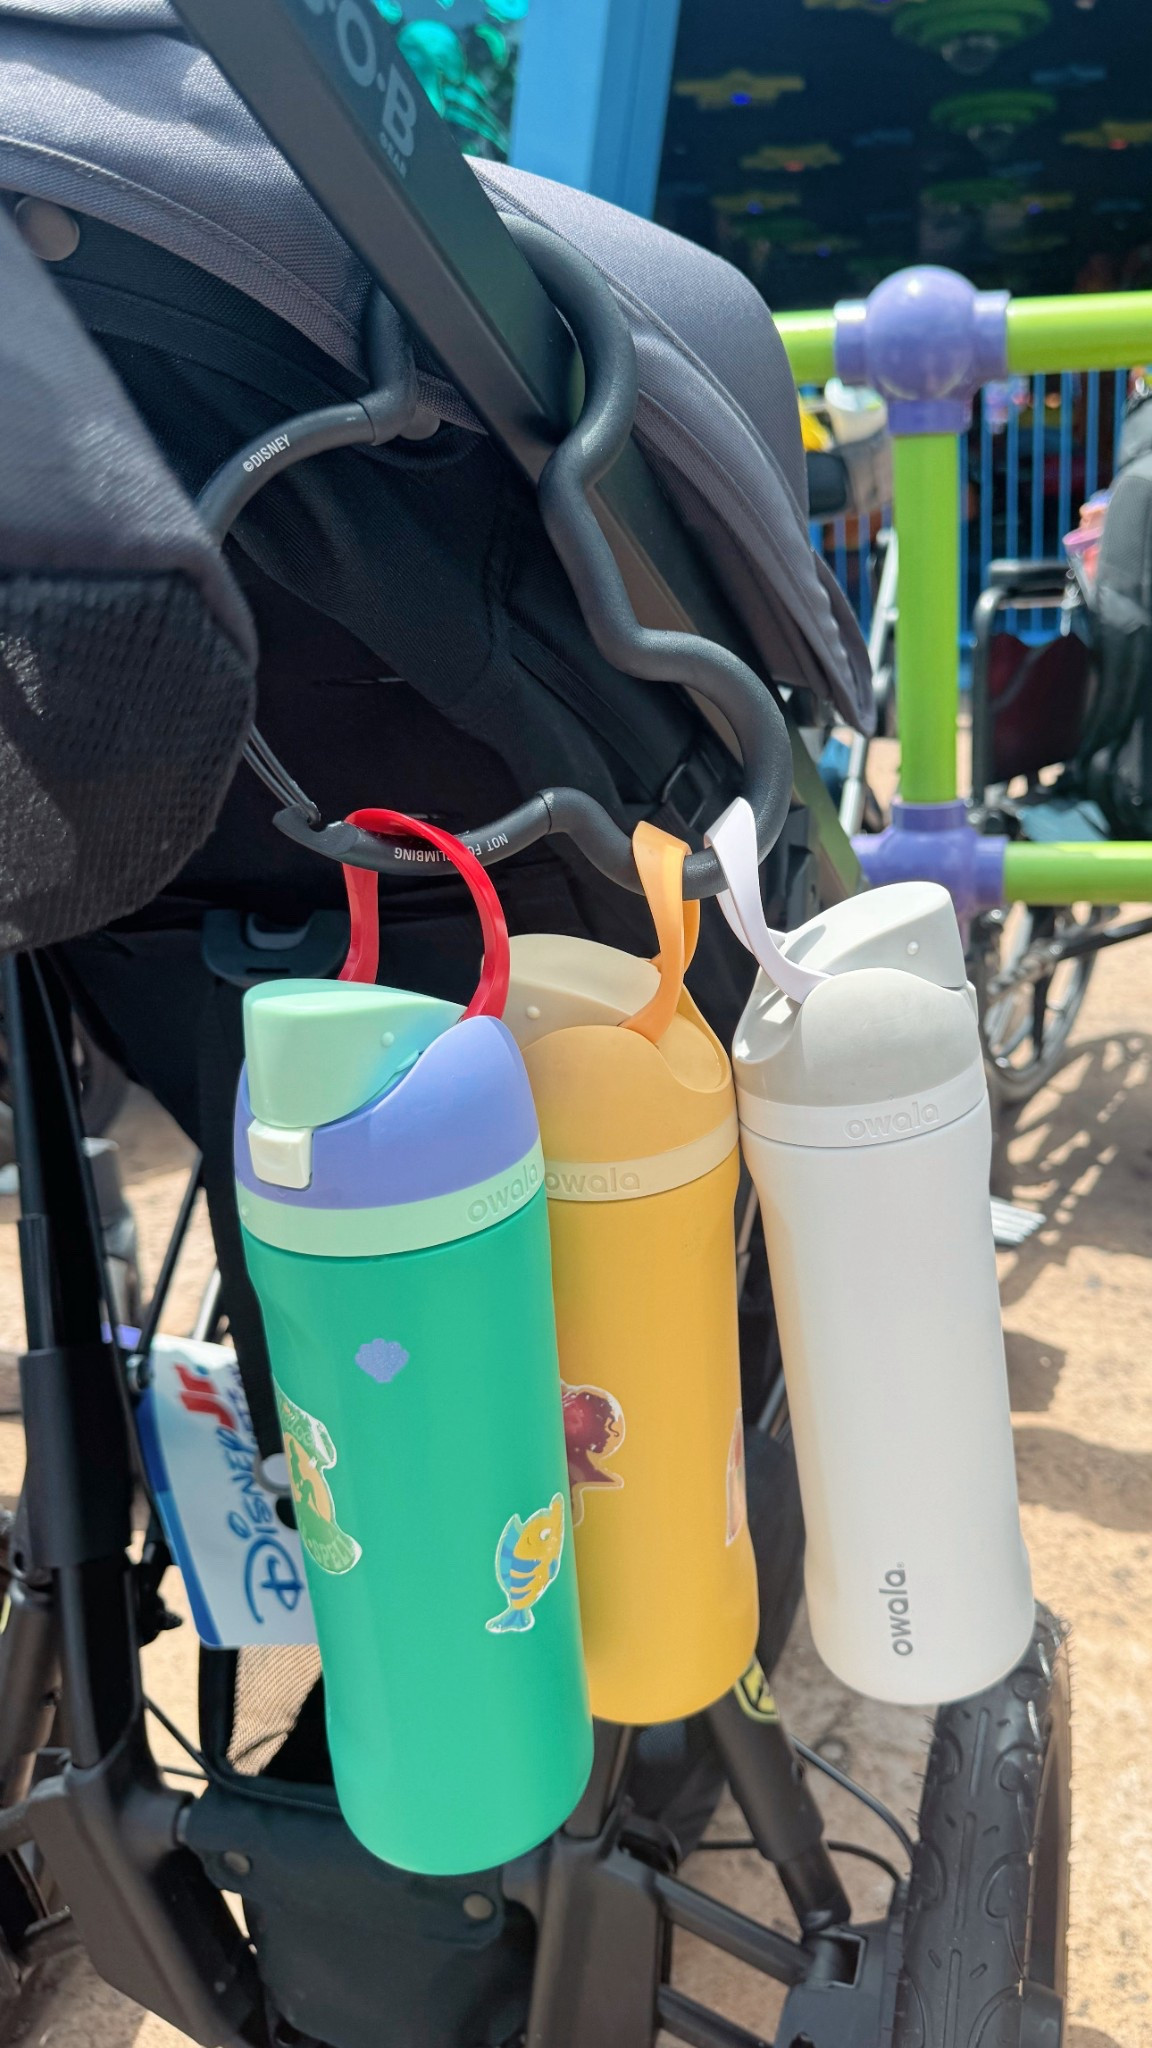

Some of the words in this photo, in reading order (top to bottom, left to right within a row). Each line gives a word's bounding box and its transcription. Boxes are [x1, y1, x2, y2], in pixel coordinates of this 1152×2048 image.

[394, 847, 452, 862] LIMBING
[487, 832, 509, 852] NOT
[843, 1101, 940, 1140] owala
[467, 1163, 539, 1222] owala
[544, 1167, 641, 1194] owala
